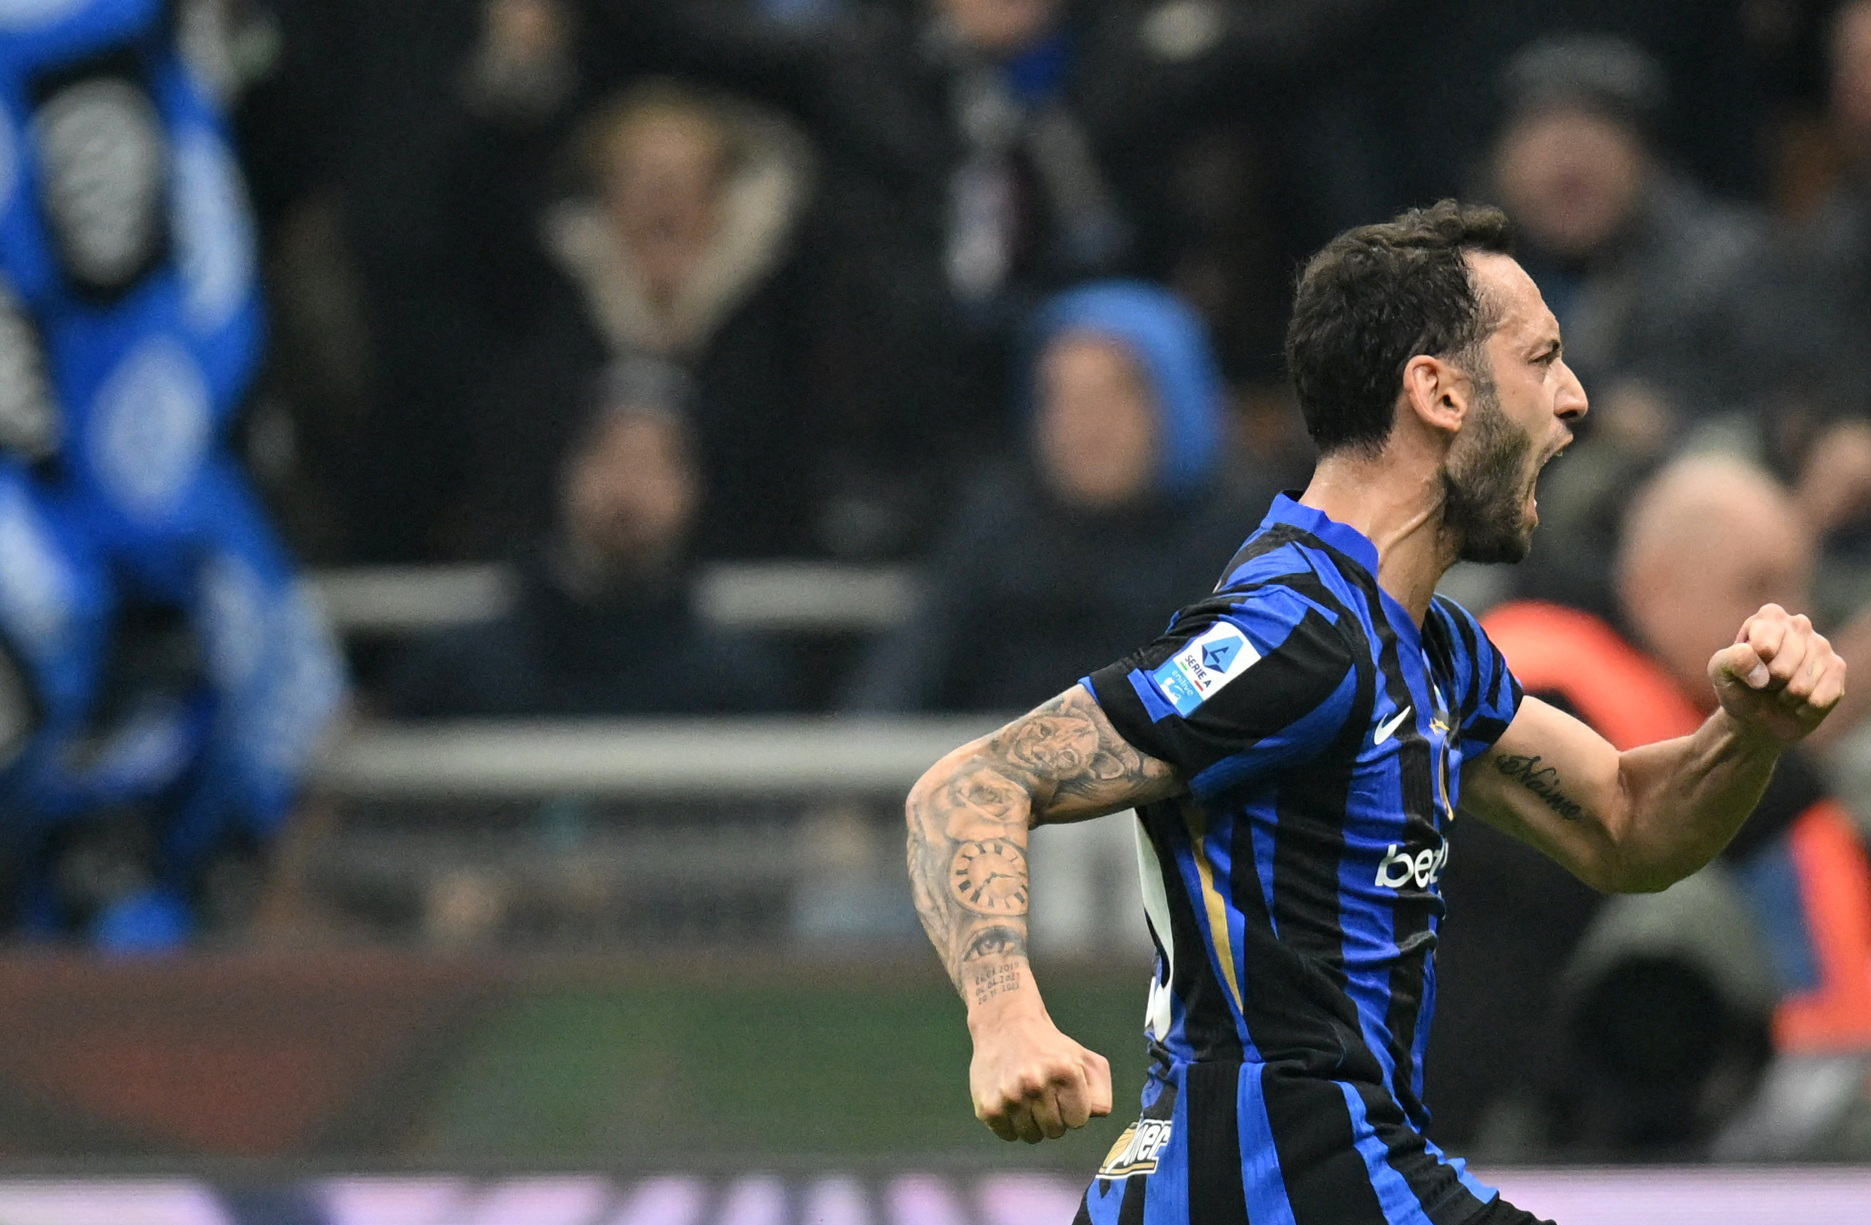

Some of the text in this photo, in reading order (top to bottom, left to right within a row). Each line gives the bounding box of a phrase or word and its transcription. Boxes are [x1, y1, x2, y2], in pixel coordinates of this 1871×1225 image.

[1171, 670, 1194, 696] enilive
[1185, 654, 1212, 688] SERIE A
